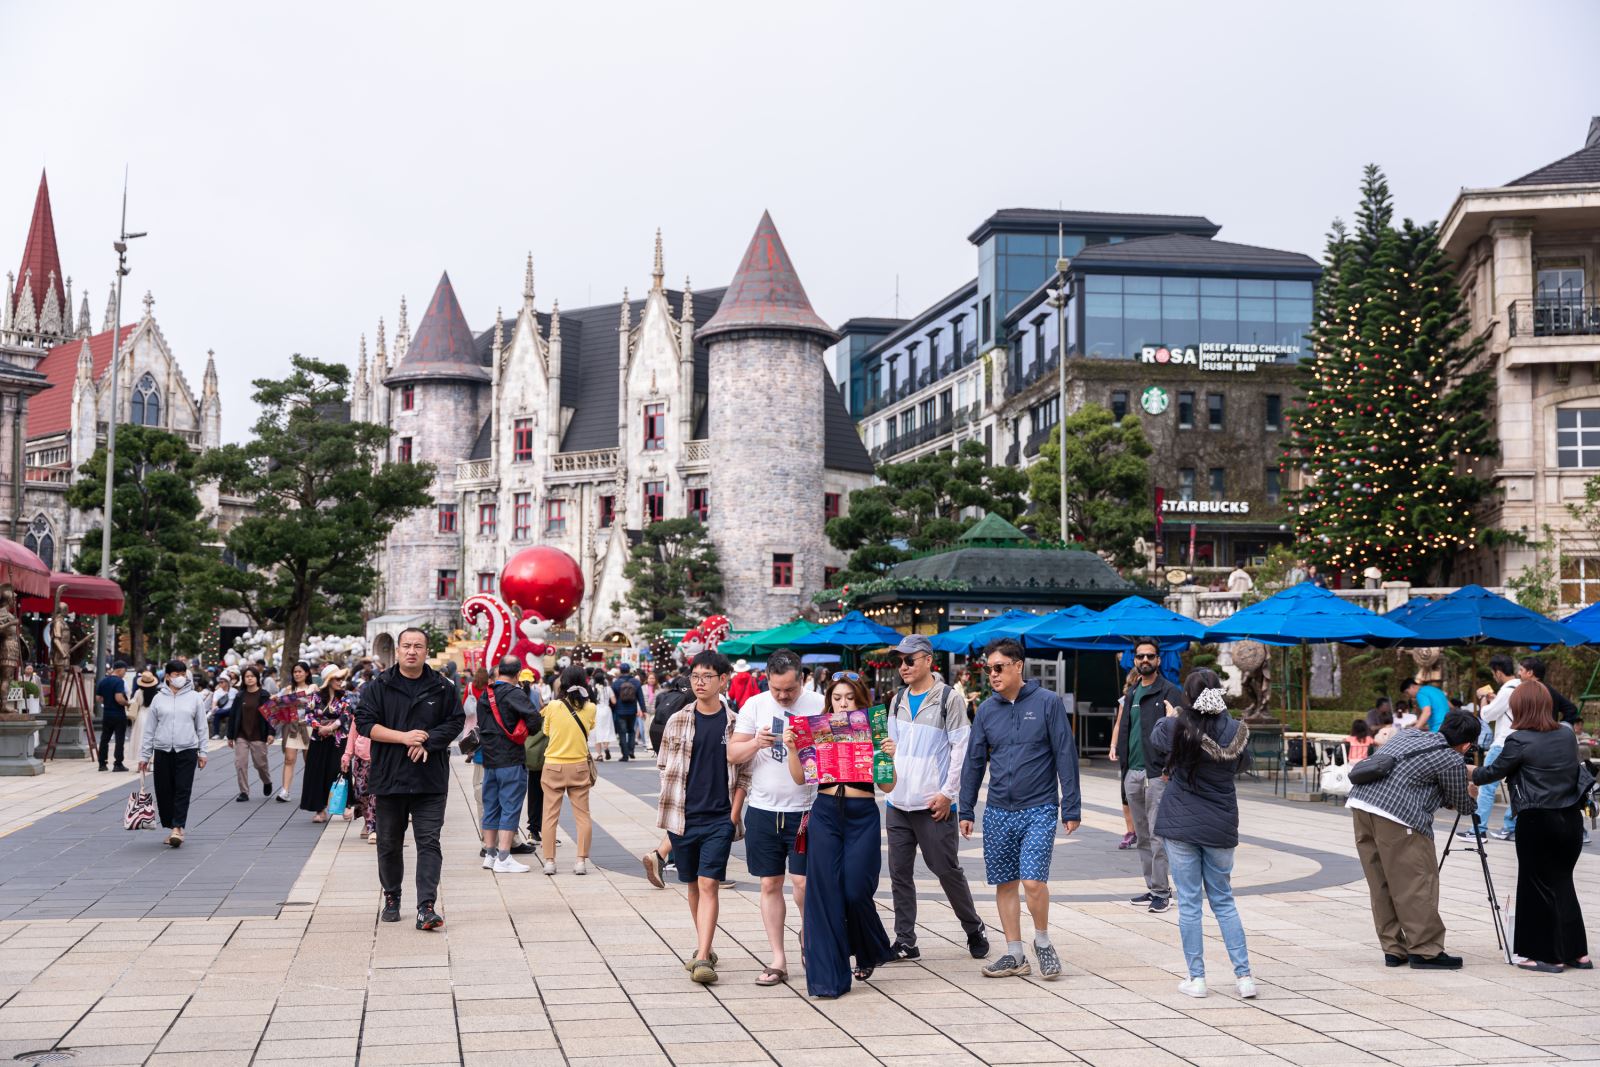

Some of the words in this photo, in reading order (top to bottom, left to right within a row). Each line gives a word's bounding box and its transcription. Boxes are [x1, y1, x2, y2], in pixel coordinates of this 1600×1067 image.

[1203, 343, 1228, 352] DEEP
[1229, 344, 1258, 352] FRIED
[1259, 345, 1300, 354] CHICKEN
[1142, 347, 1197, 365] ROSA
[1202, 353, 1221, 362] HOT
[1222, 353, 1241, 362] POT
[1242, 354, 1277, 363] BUFFET
[1203, 362, 1233, 371] SUSHI
[1235, 363, 1256, 372] BAR
[1161, 500, 1250, 513] STARBUCKS
